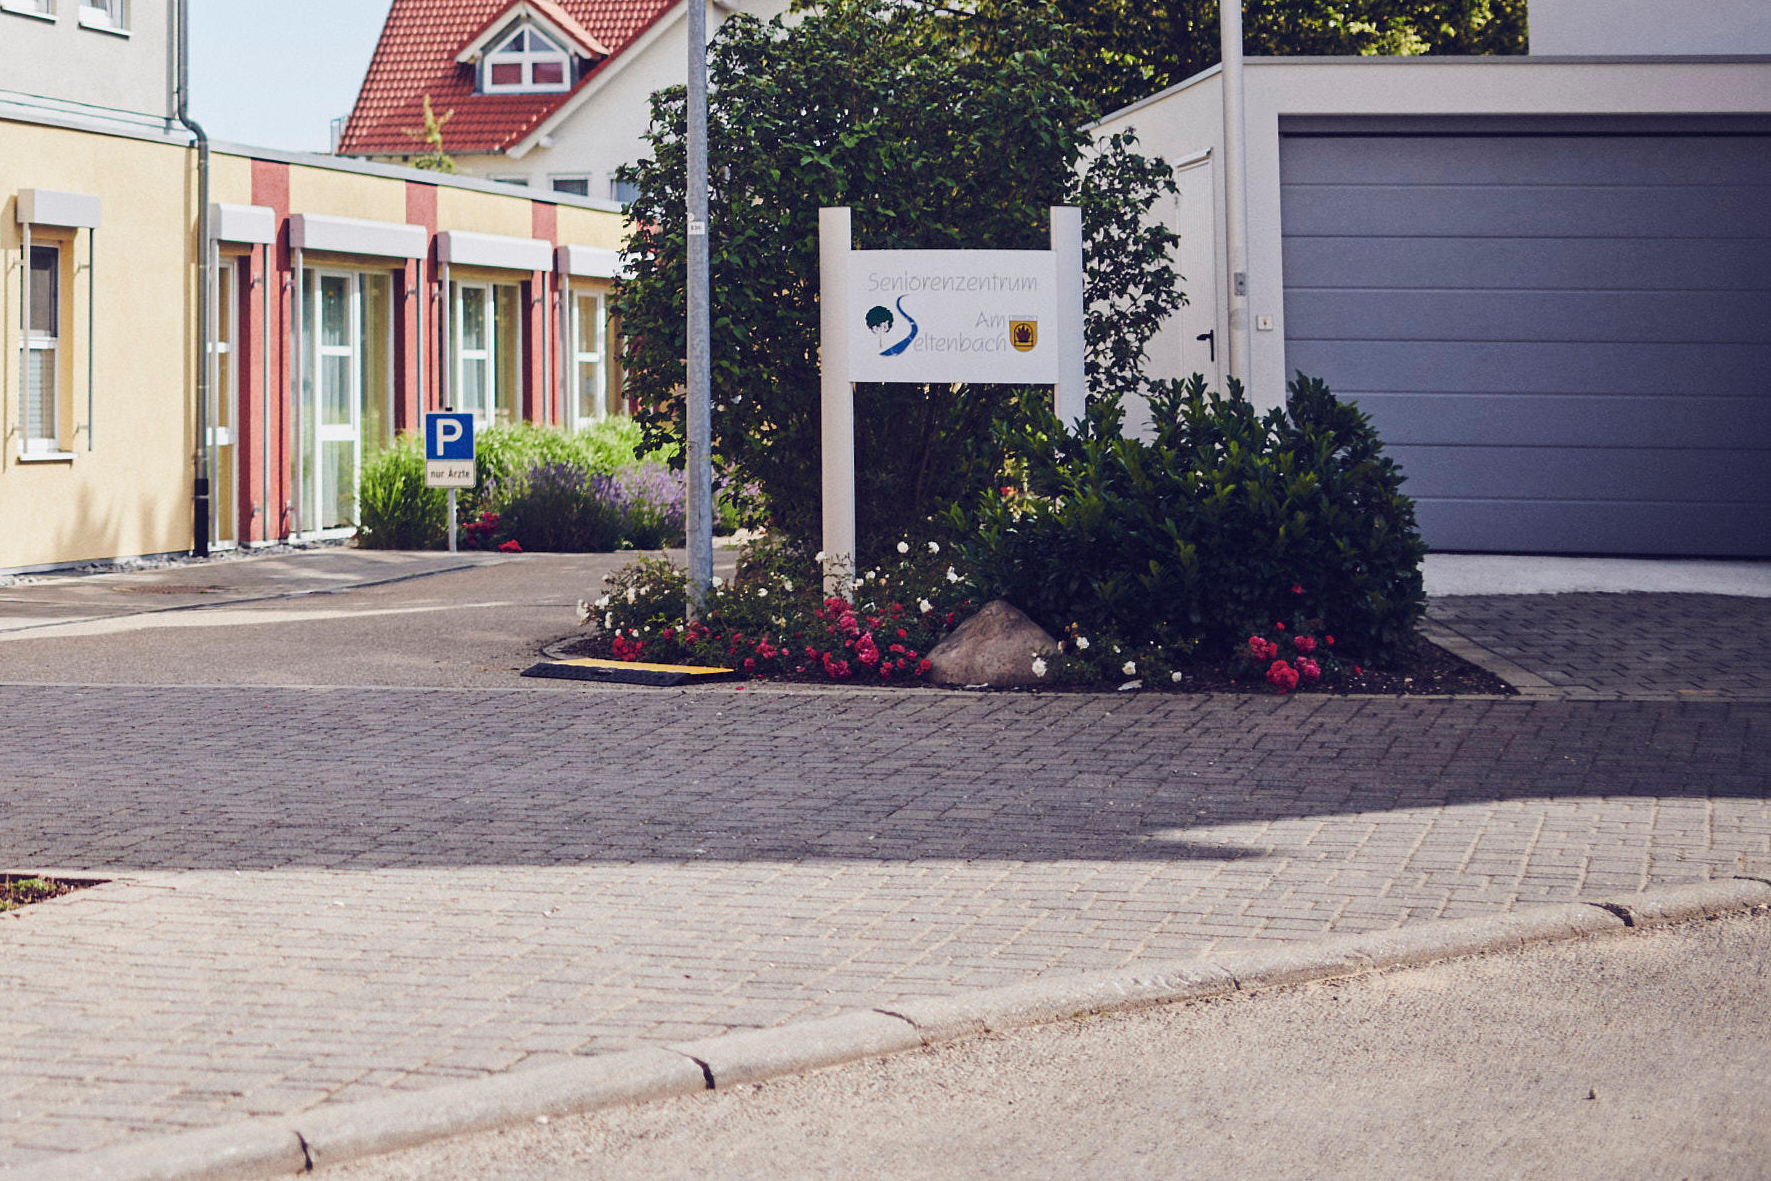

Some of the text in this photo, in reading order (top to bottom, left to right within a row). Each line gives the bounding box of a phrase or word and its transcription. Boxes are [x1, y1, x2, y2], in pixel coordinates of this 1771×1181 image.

[868, 271, 1038, 292] Seniorenzentrum
[975, 312, 1006, 328] Am
[436, 418, 463, 457] P
[430, 470, 445, 479] nur
